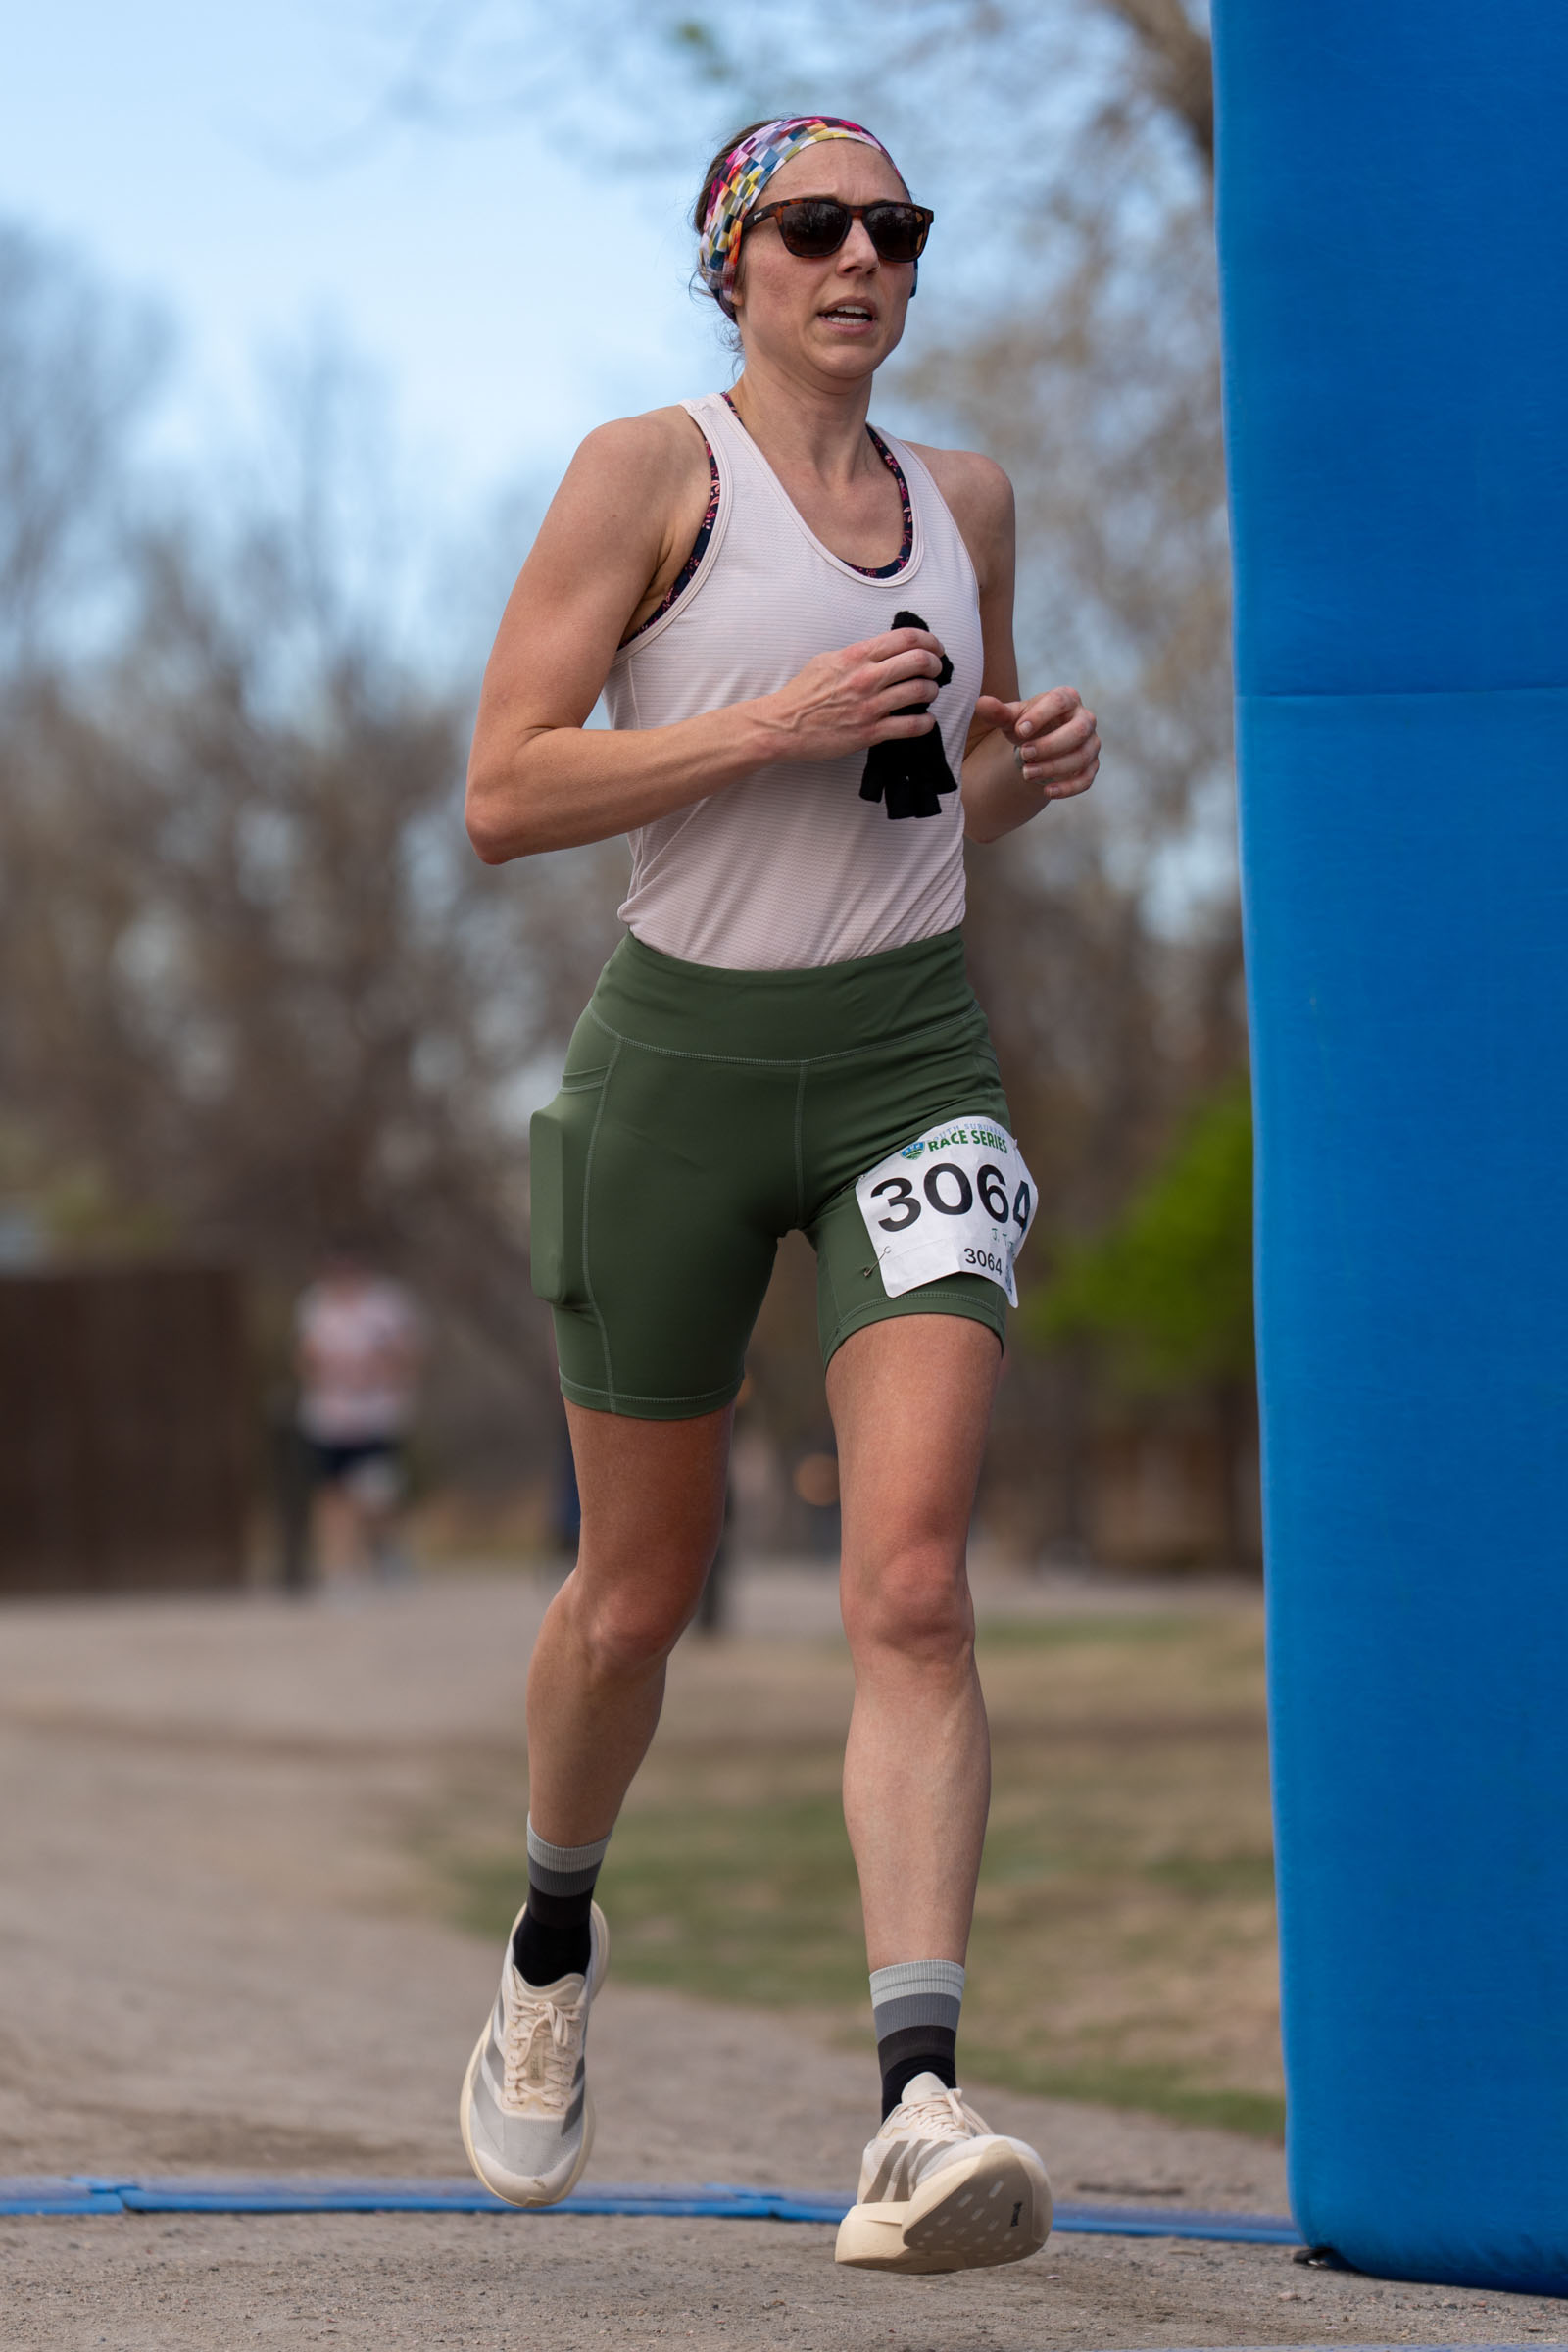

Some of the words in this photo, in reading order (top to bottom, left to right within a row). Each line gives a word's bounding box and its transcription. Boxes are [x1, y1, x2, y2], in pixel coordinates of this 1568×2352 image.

[928, 1125, 959, 1142] OUTH
[928, 1130, 968, 1152] RACE
[970, 1130, 1008, 1154] SERIES
[870, 1162, 1031, 1238] 3064
[963, 1248, 1003, 1276] 3064
